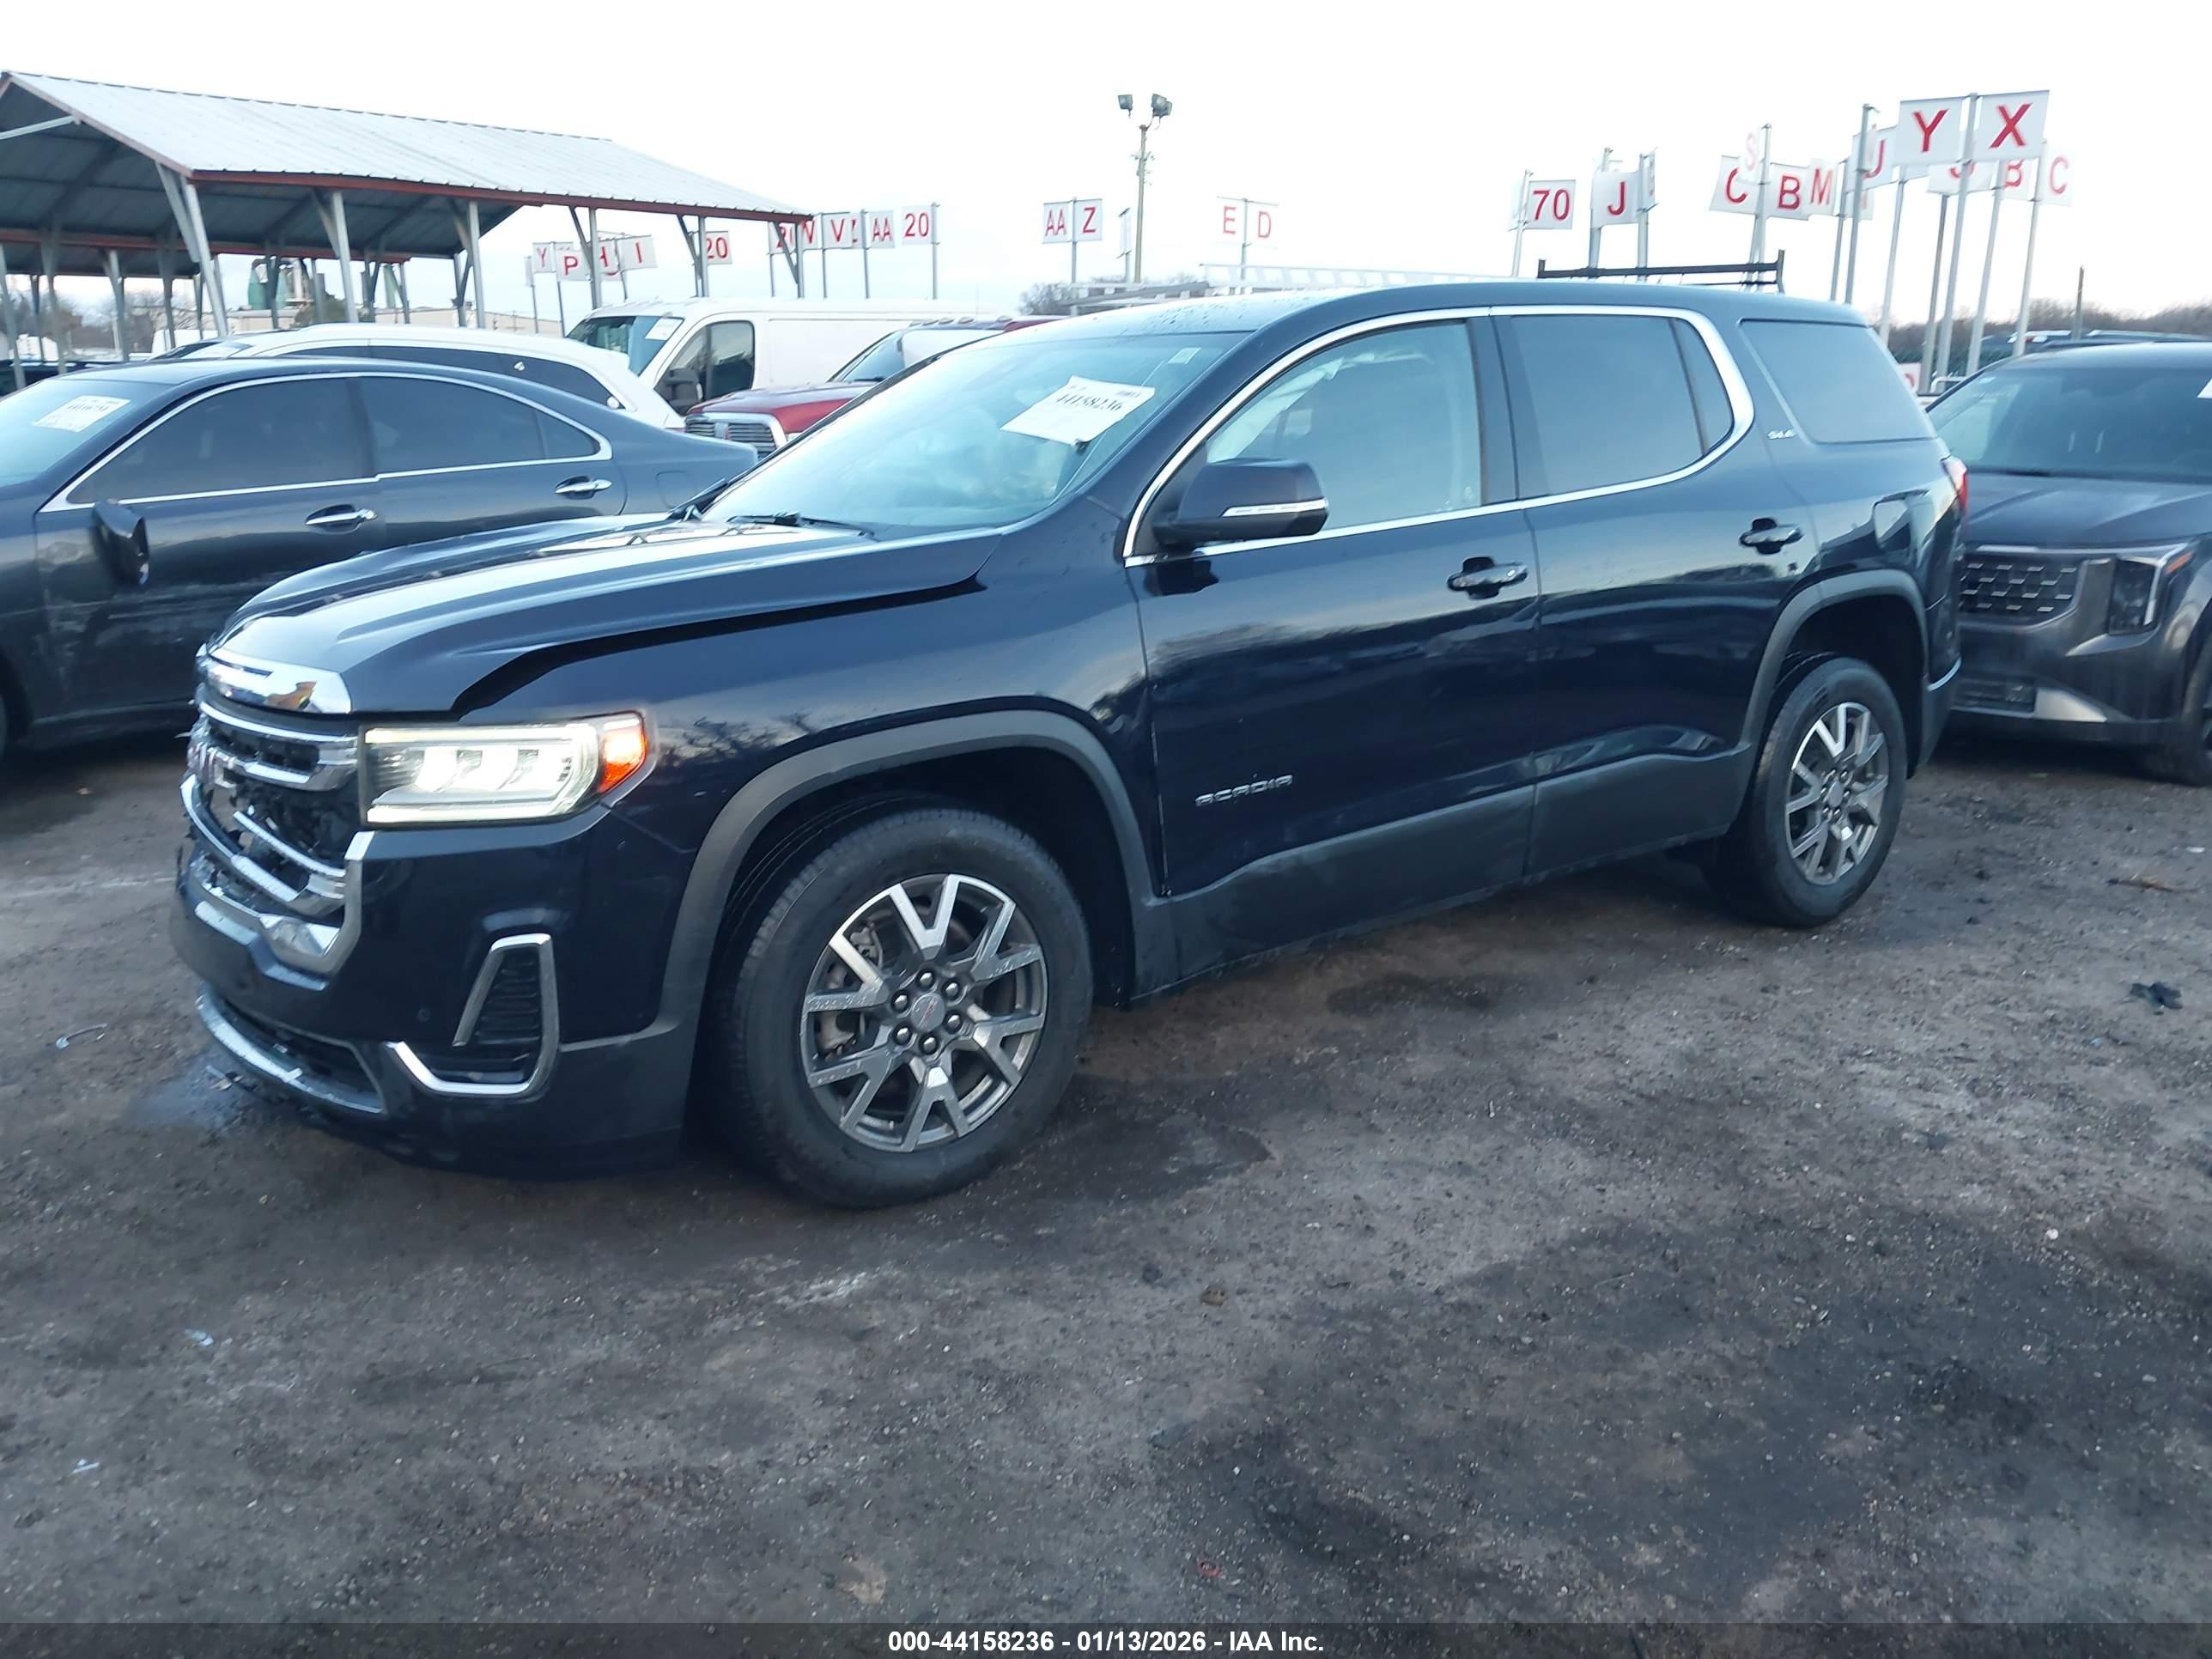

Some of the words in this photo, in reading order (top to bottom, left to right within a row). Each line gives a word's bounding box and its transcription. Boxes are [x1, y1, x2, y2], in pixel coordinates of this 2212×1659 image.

[1913, 108, 1948, 153] Y
[1989, 103, 2033, 149] X
[1725, 168, 1747, 204] C
[1809, 168, 1833, 205] M
[2048, 156, 2068, 194] C
[1532, 189, 1570, 221] 70
[1607, 181, 1626, 216] J
[1778, 175, 1800, 210] B
[830, 219, 845, 242] V
[872, 218, 892, 242] AA
[905, 213, 928, 237] 20
[1045, 210, 1066, 235] AA
[1082, 207, 1096, 233] Z
[1224, 206, 1237, 234] E
[1258, 210, 1272, 239] D
[537, 246, 547, 268] Y
[563, 256, 579, 276] P
[1194, 775, 1293, 807] ACADIA
